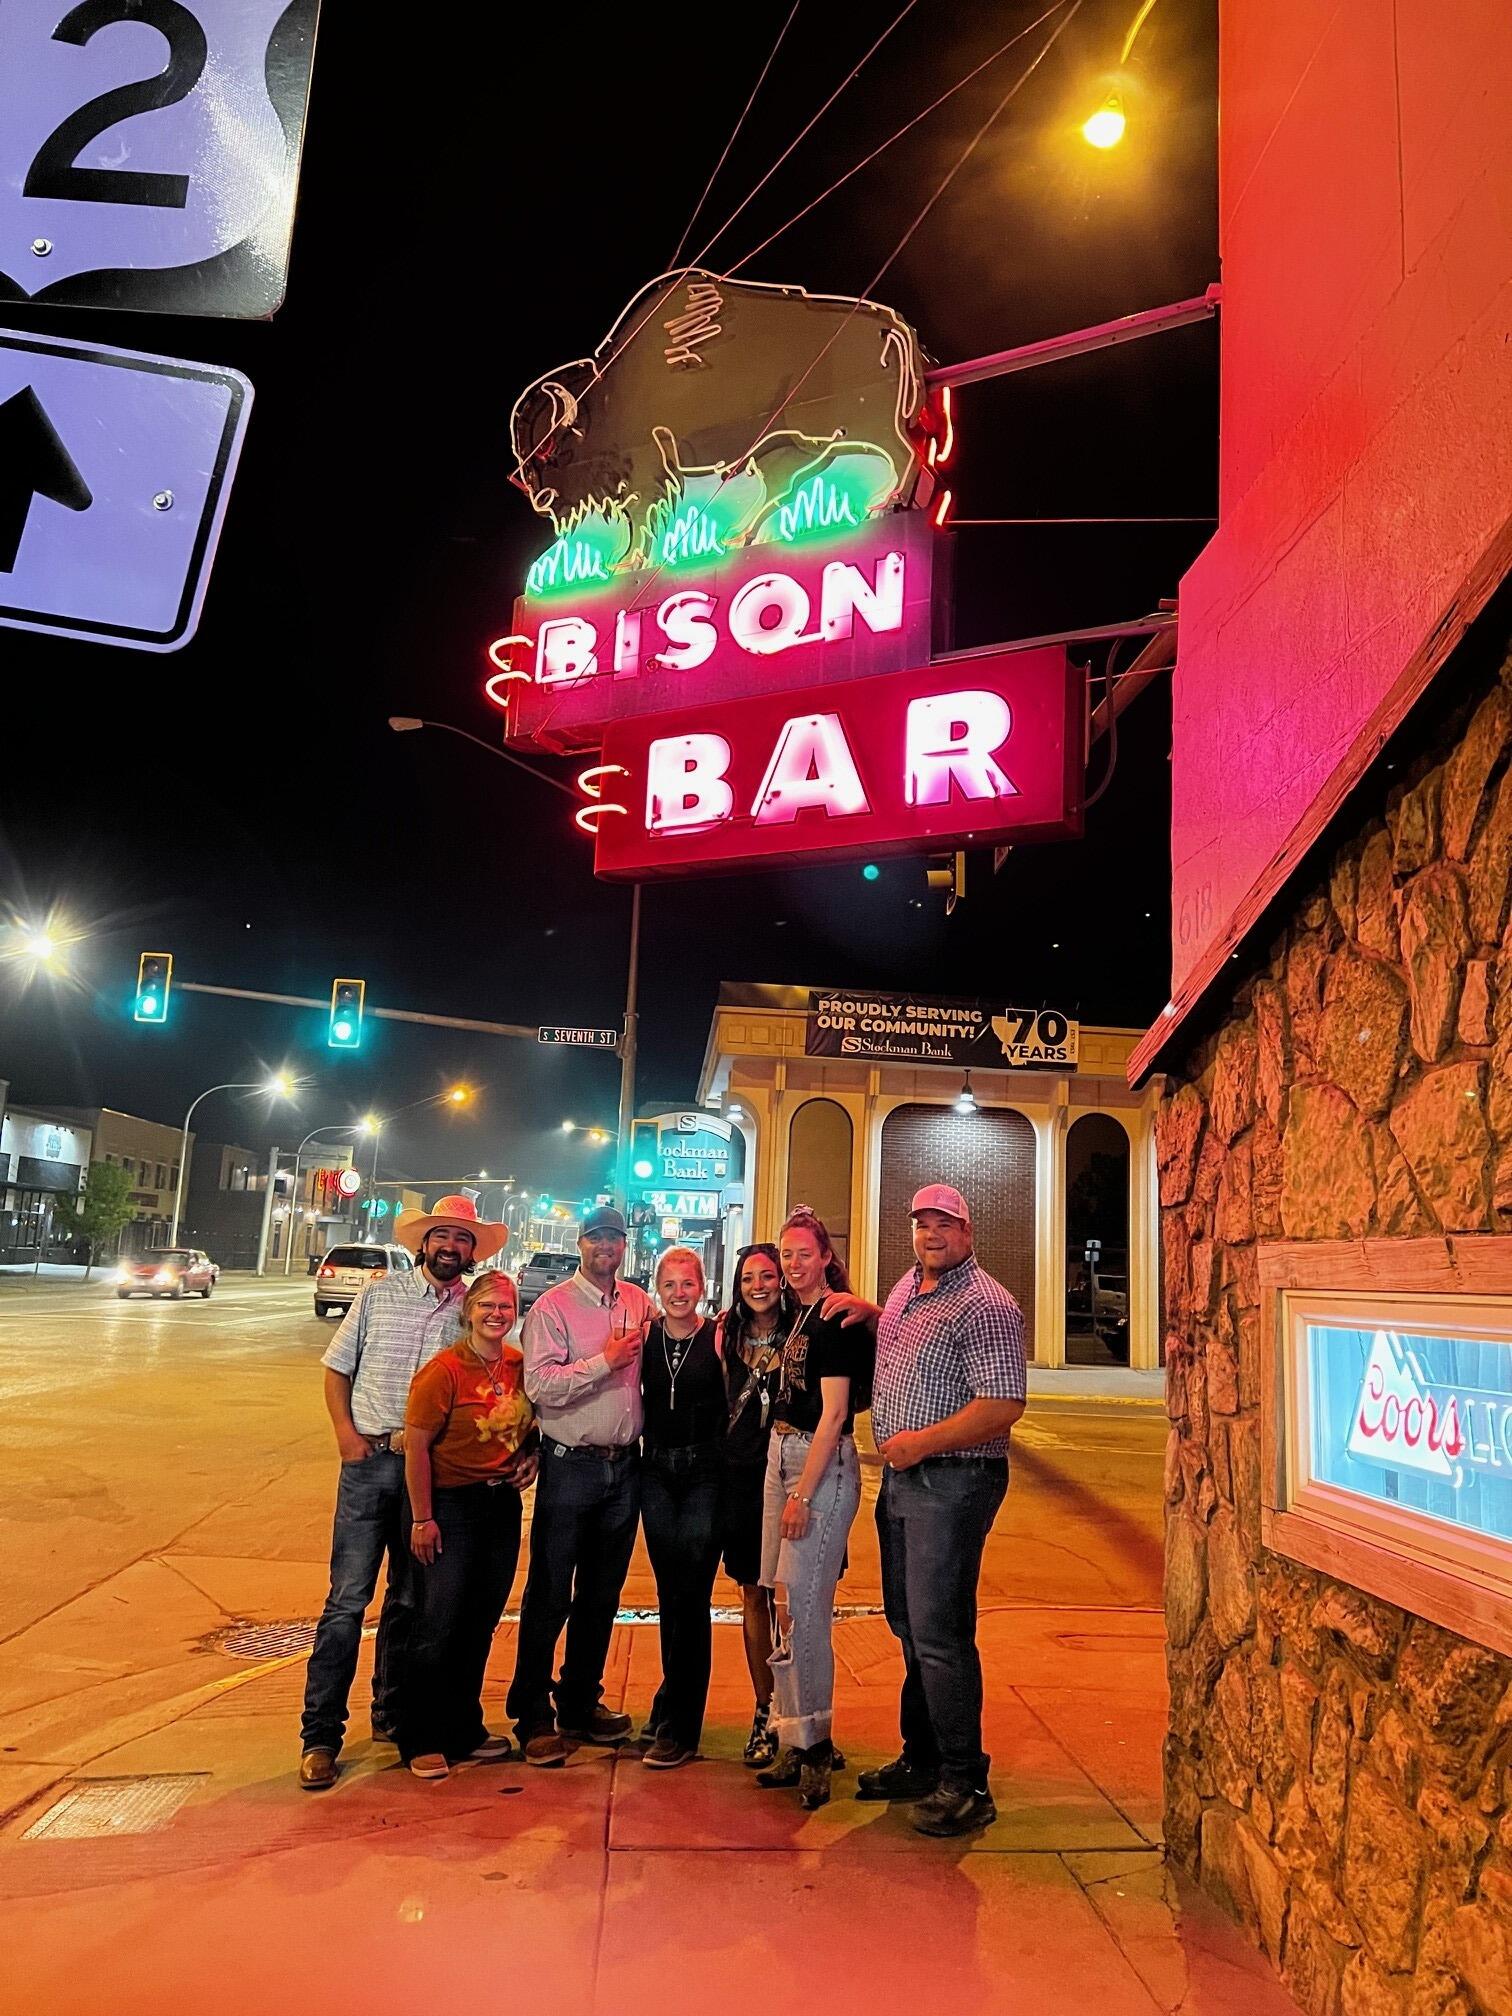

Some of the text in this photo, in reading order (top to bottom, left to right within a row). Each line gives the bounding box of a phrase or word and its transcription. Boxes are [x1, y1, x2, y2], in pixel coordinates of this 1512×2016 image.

[23, 0, 207, 209] 2
[535, 552, 906, 692] BISON
[645, 690, 1021, 839] BAR
[818, 1000, 983, 1023] PROUDLY SERVING
[543, 1029, 612, 1044] S SEVENTH ST
[817, 1015, 975, 1039] OUR COMMUNITY!
[1006, 1008, 1068, 1046] 70
[861, 1038, 917, 1054] Stockman
[921, 1041, 952, 1057] Bank
[1007, 1045, 1067, 1060] YEARS
[657, 1139, 729, 1159] tockman
[663, 1160, 709, 1179] Bank
[673, 1195, 716, 1216] ATM
[1358, 1364, 1465, 1457] Coors
